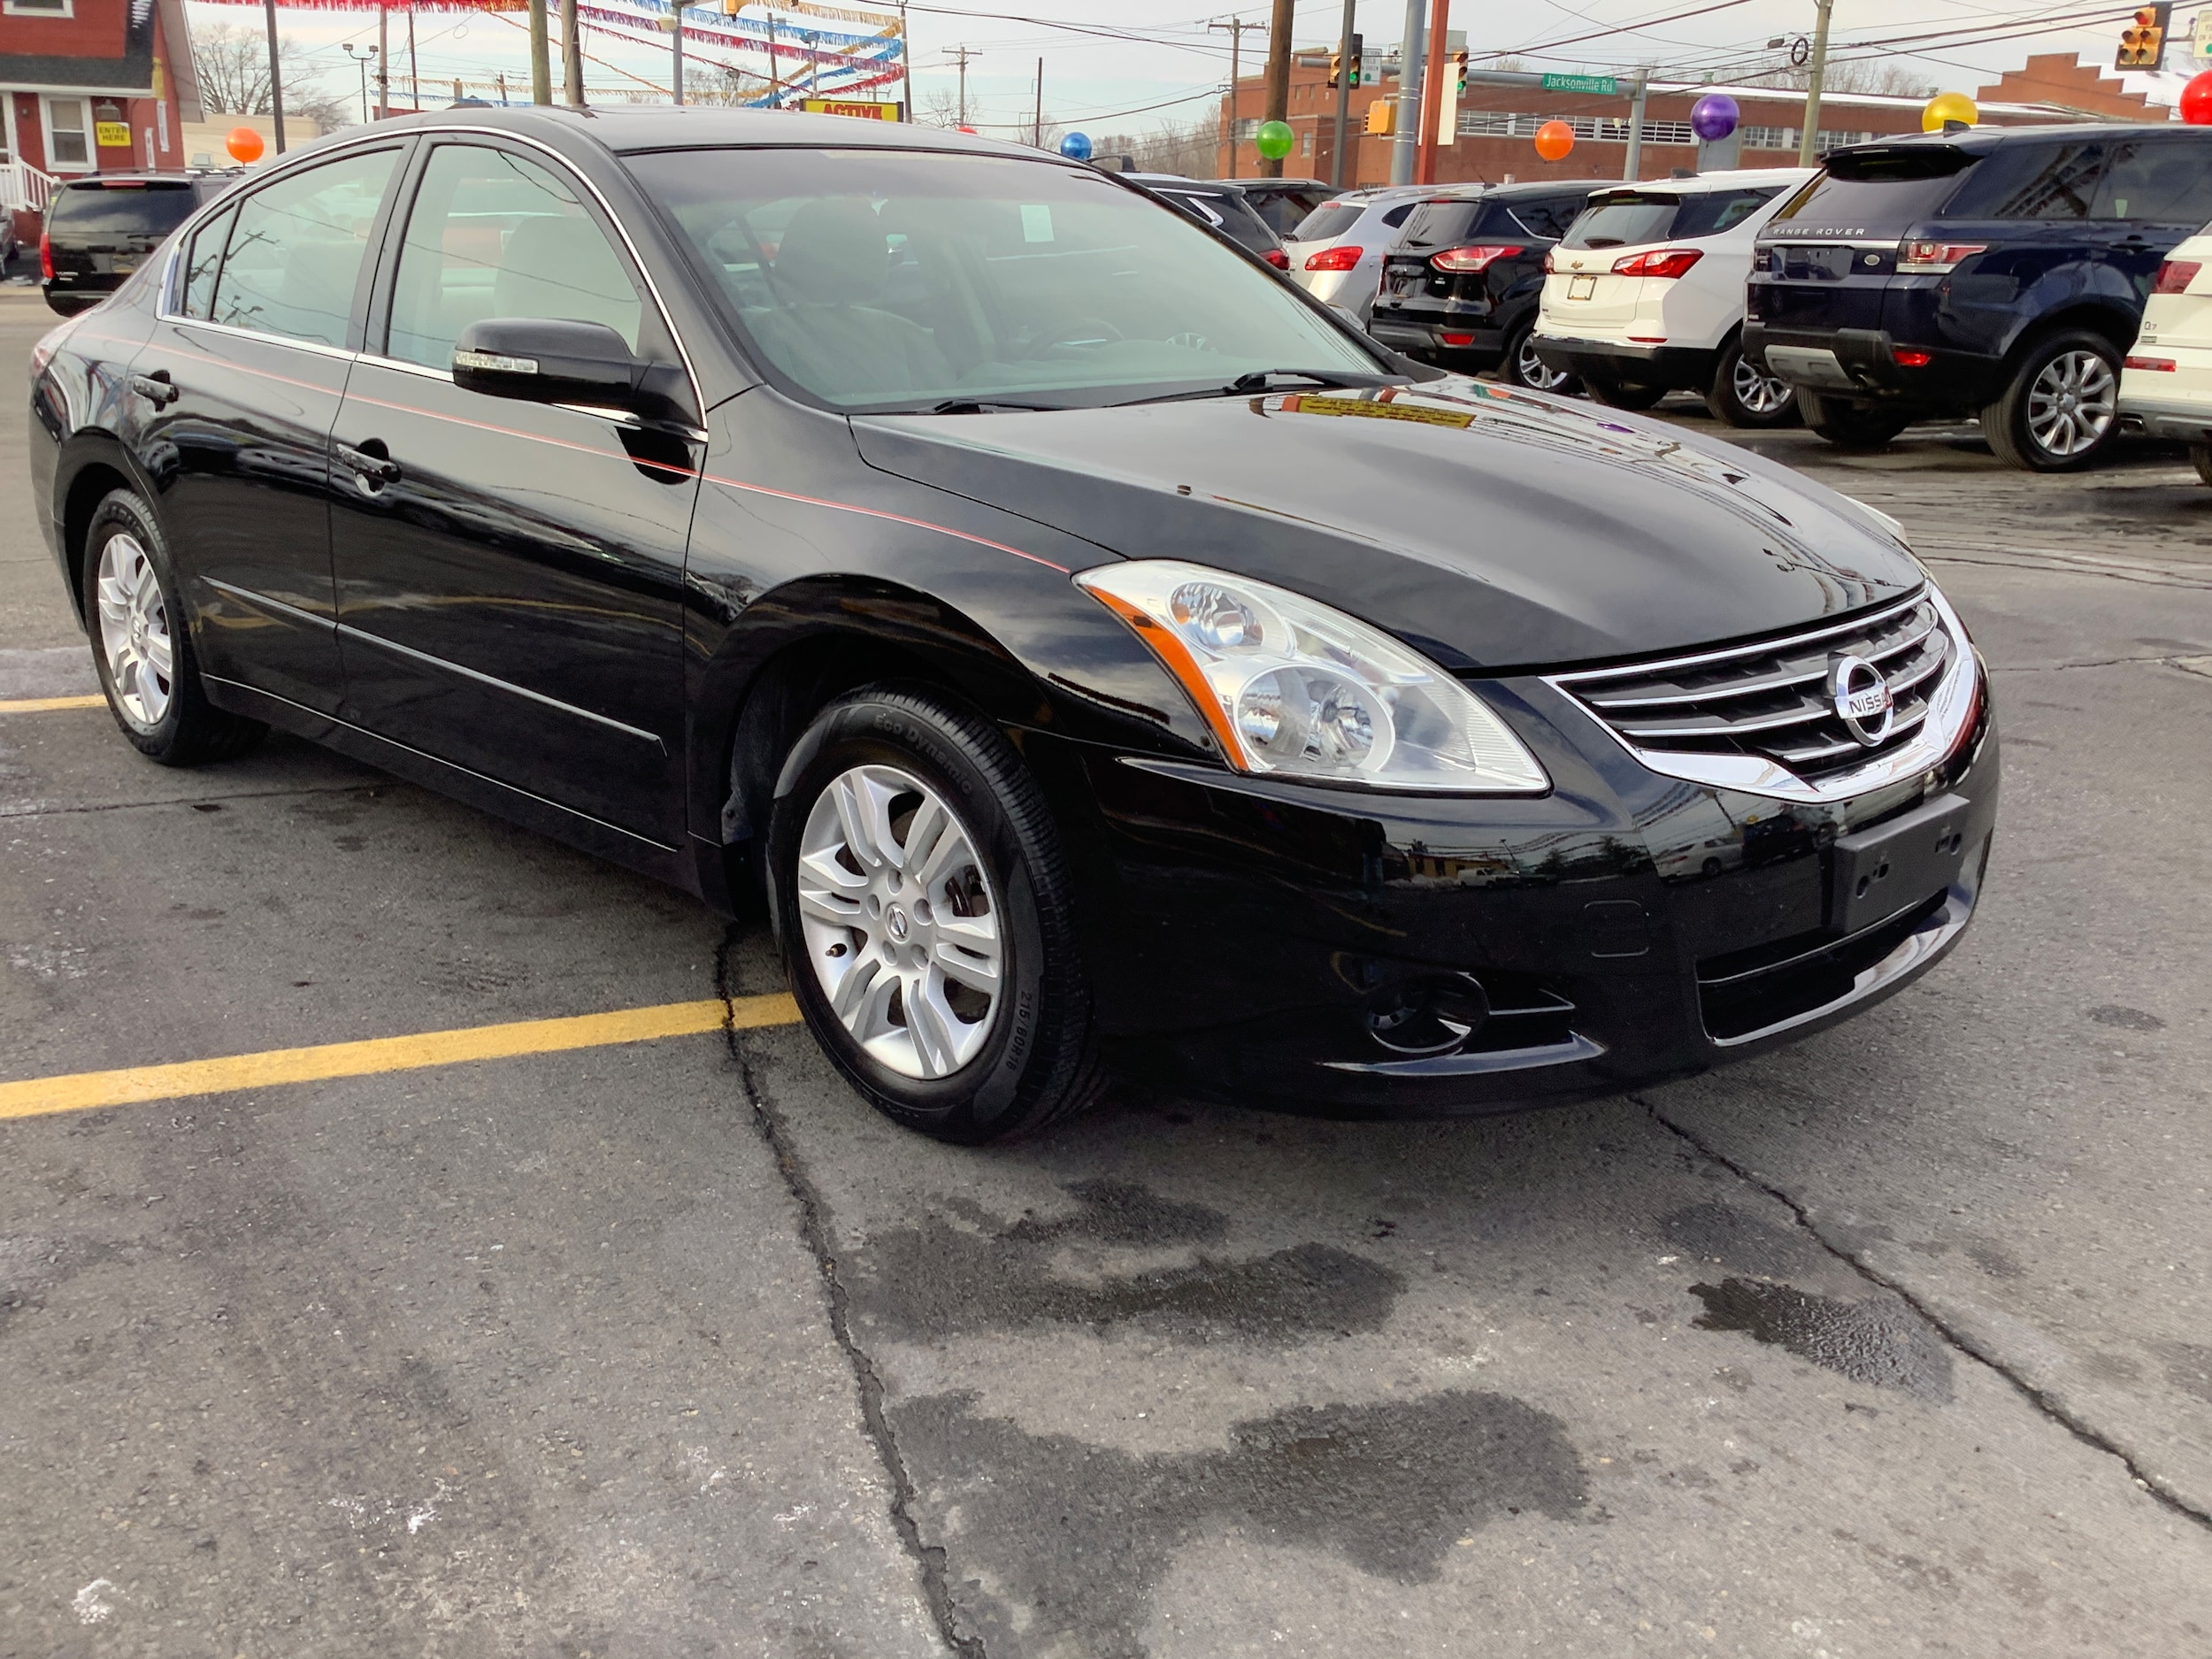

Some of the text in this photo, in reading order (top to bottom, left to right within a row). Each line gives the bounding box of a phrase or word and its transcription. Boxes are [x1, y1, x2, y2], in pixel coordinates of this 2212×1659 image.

[1547, 74, 1613, 91] Jacksonville Rd
[874, 714, 973, 795] Eco Dynamic
